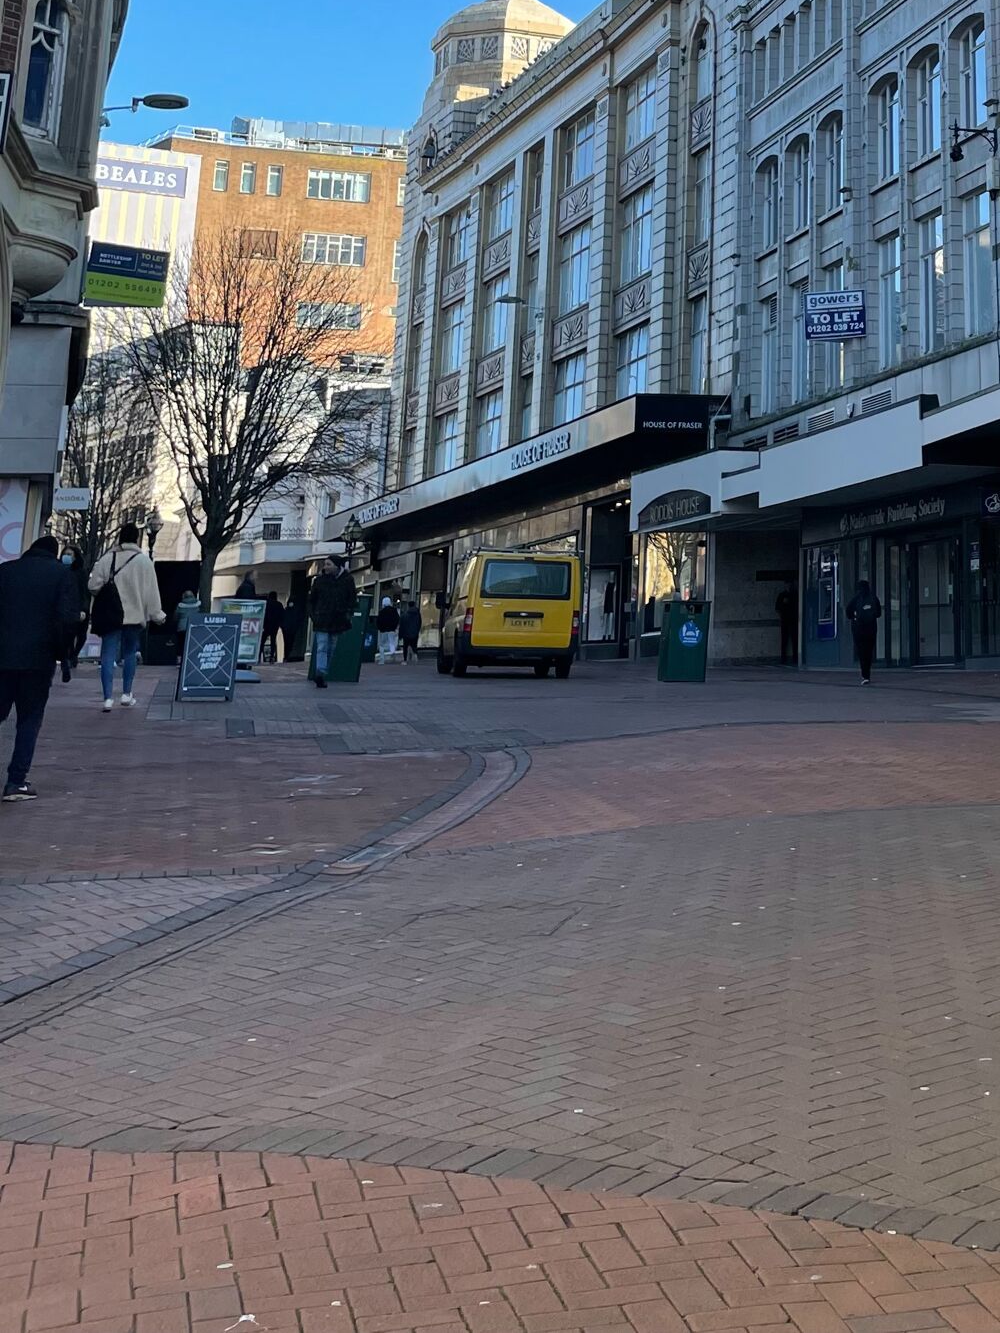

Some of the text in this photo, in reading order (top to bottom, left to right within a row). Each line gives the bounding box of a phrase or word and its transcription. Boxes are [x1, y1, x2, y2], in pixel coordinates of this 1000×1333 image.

[96, 164, 177, 188] BEALES
[810, 293, 860, 307] gowers
[811, 311, 860, 324] TO LET
[807, 325, 832, 333] 01202
[849, 322, 864, 330] 724
[643, 421, 703, 429] HOUSE OF FRASER
[512, 432, 571, 470] HOUSE OF FRASER
[649, 496, 700, 523] RODDIS HOUSE
[919, 497, 945, 517] Society
[204, 616, 226, 624] LUSH
